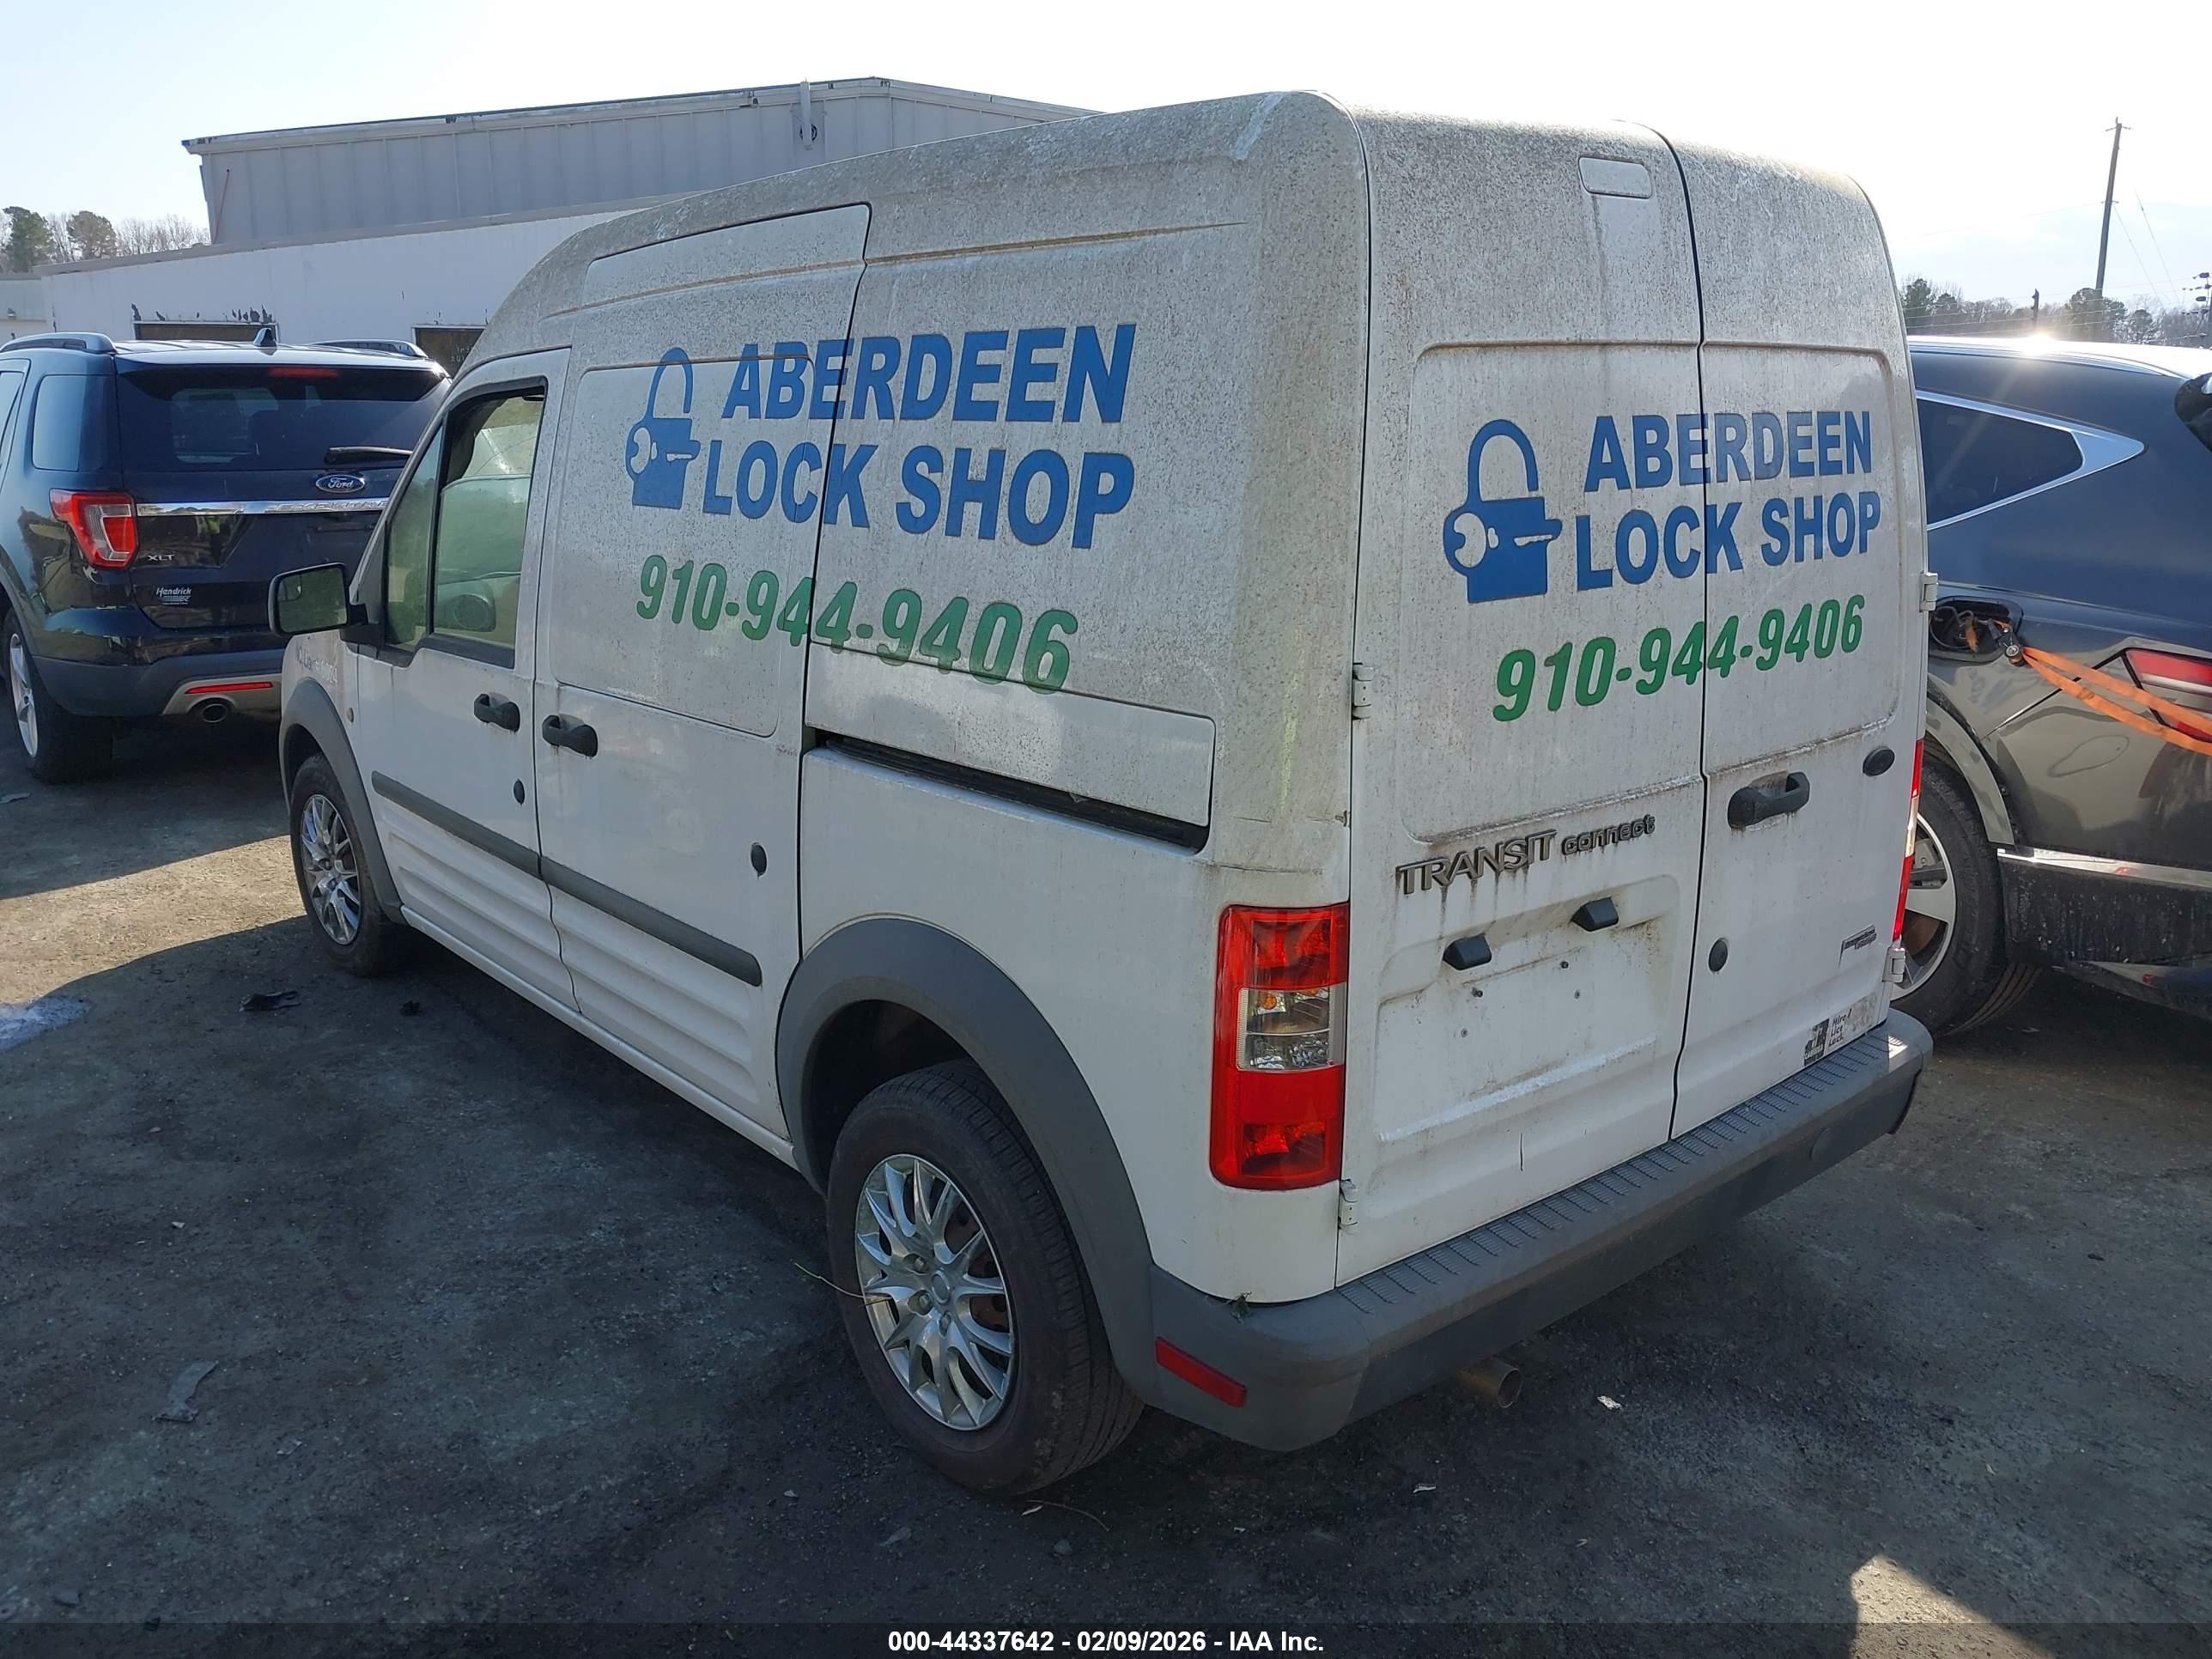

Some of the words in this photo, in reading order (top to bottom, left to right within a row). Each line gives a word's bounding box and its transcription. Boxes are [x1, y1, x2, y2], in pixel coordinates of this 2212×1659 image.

[721, 324, 1136, 422] ABERDEEN
[328, 477, 354, 489] Ford
[702, 440, 878, 529] LOCK
[895, 445, 1135, 550] SHOP
[1584, 410, 1872, 492] ABERDEEN
[1576, 501, 1743, 591] LOCK
[1760, 491, 1881, 567] SHOP
[155, 587, 191, 598] Hendrick
[636, 555, 1079, 694] 910-944-9406
[1492, 594, 1865, 721] 910-944-9406
[1395, 829, 1557, 895] TRANSIT
[1562, 814, 1656, 856] connect
